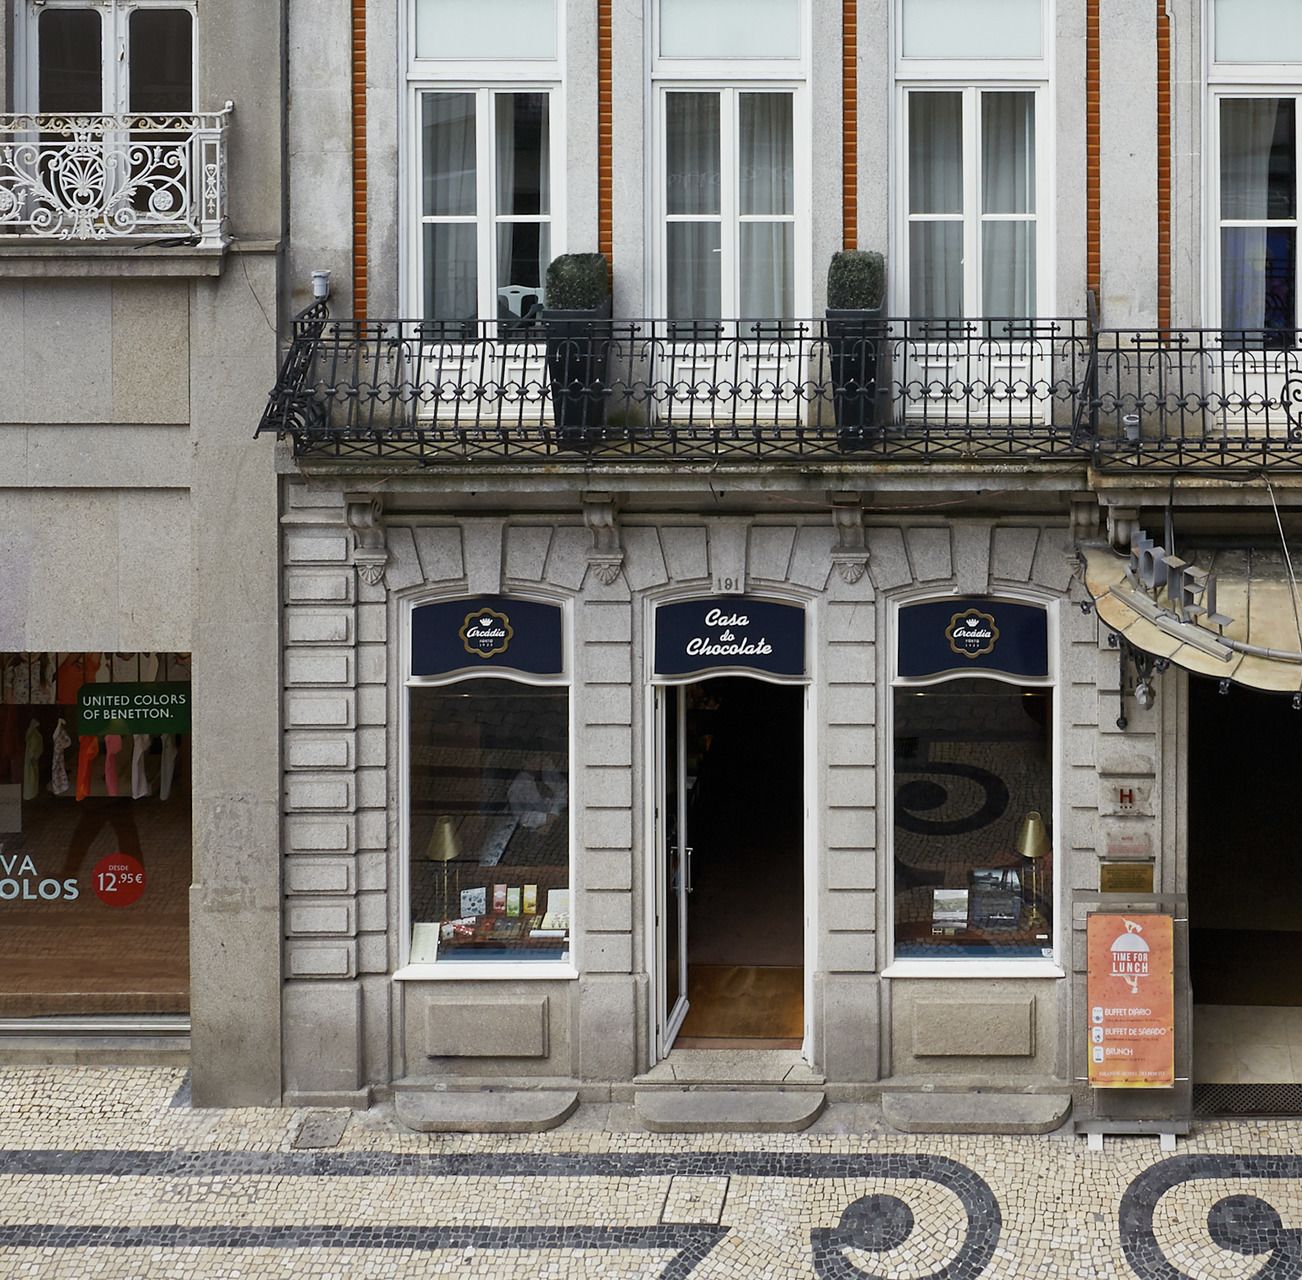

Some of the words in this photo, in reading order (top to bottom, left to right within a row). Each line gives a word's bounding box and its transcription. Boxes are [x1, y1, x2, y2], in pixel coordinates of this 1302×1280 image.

[717, 578, 739, 591] 191
[705, 608, 750, 627] Casa
[720, 629, 735, 641] do
[686, 637, 773, 655] Chocolate
[82, 695, 130, 707] UNITED
[133, 694, 187, 706] COLORS
[83, 710, 100, 720] OF
[103, 708, 174, 720] BENETTON.
[1120, 789, 1132, 803] H
[1113, 952, 1131, 961] TIME
[1133, 952, 1148, 961] FOR
[1112, 962, 1148, 973] LUNCH
